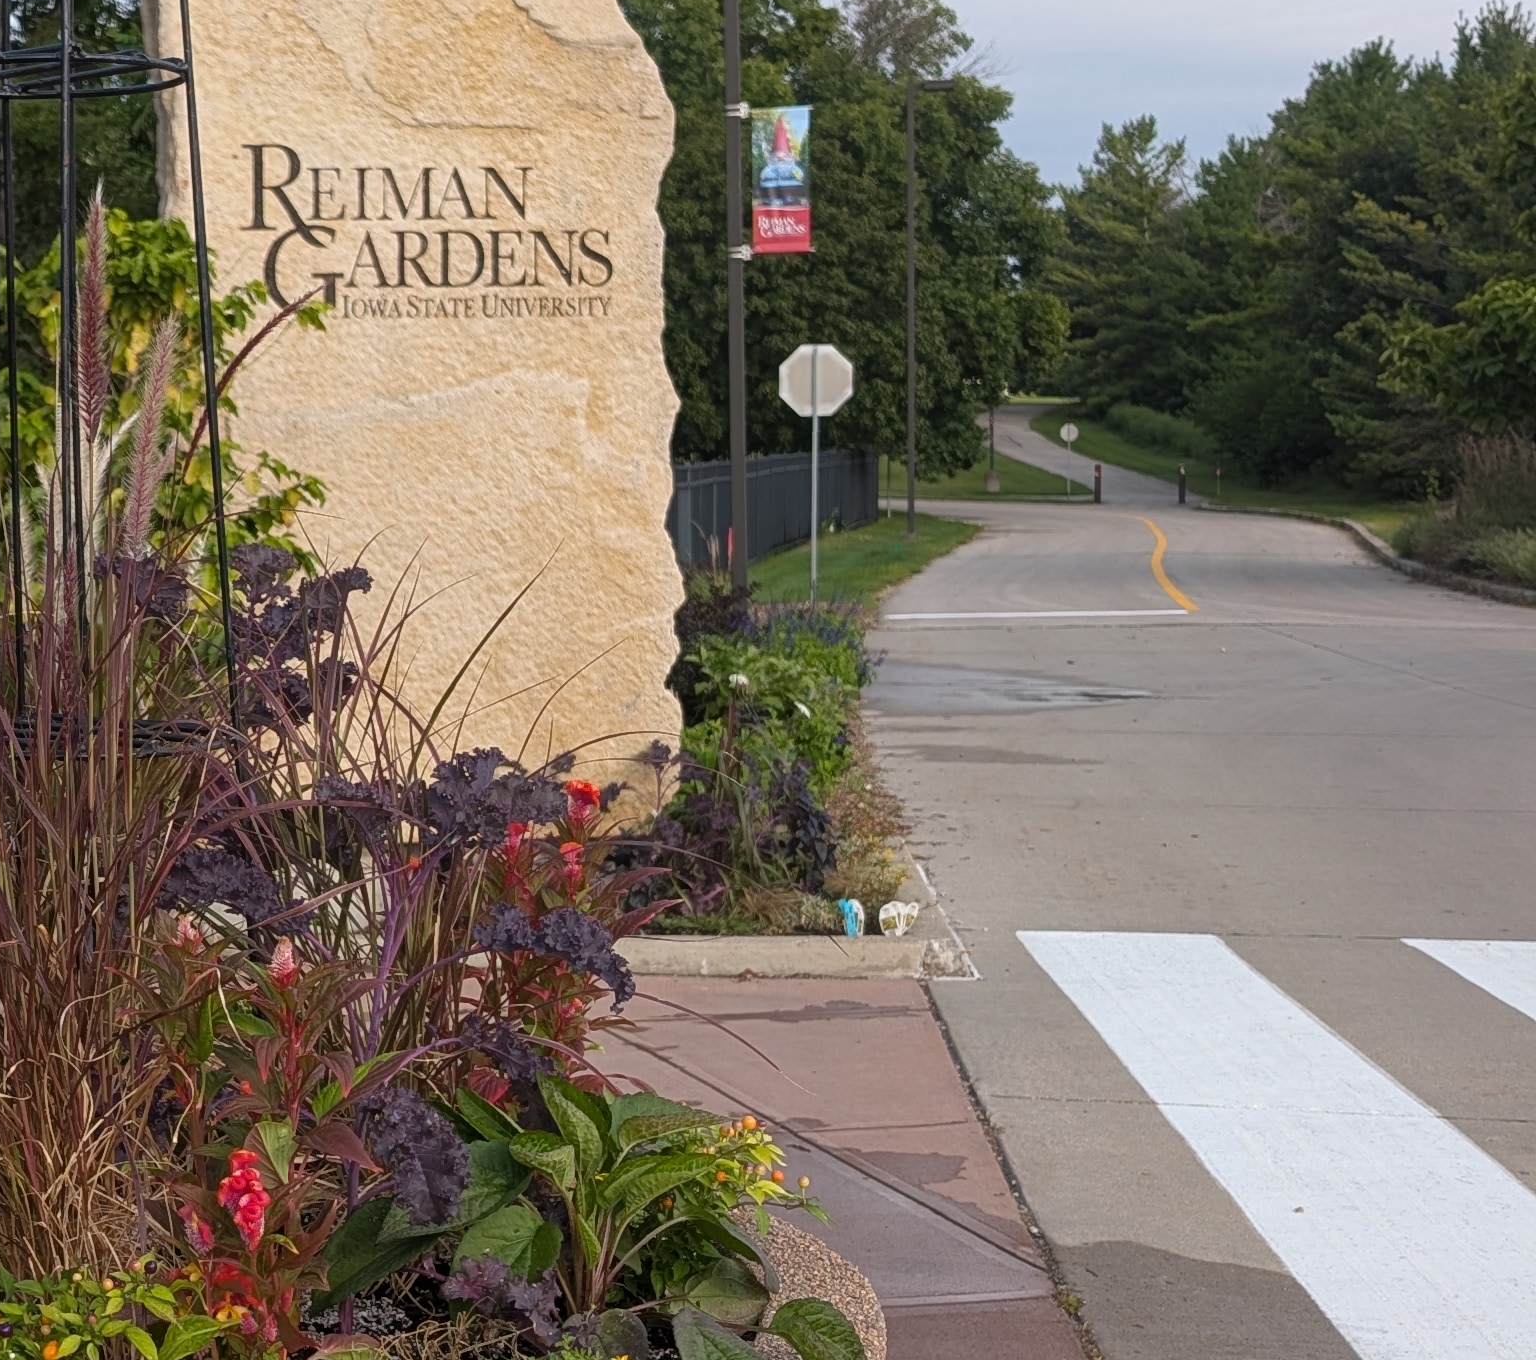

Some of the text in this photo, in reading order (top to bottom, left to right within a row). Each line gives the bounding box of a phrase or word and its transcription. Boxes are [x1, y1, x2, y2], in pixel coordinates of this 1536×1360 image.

[240, 143, 534, 248] REIMAN
[263, 224, 614, 312] GARDENS
[342, 294, 613, 319] IOWA STATE UNIVERSITY
